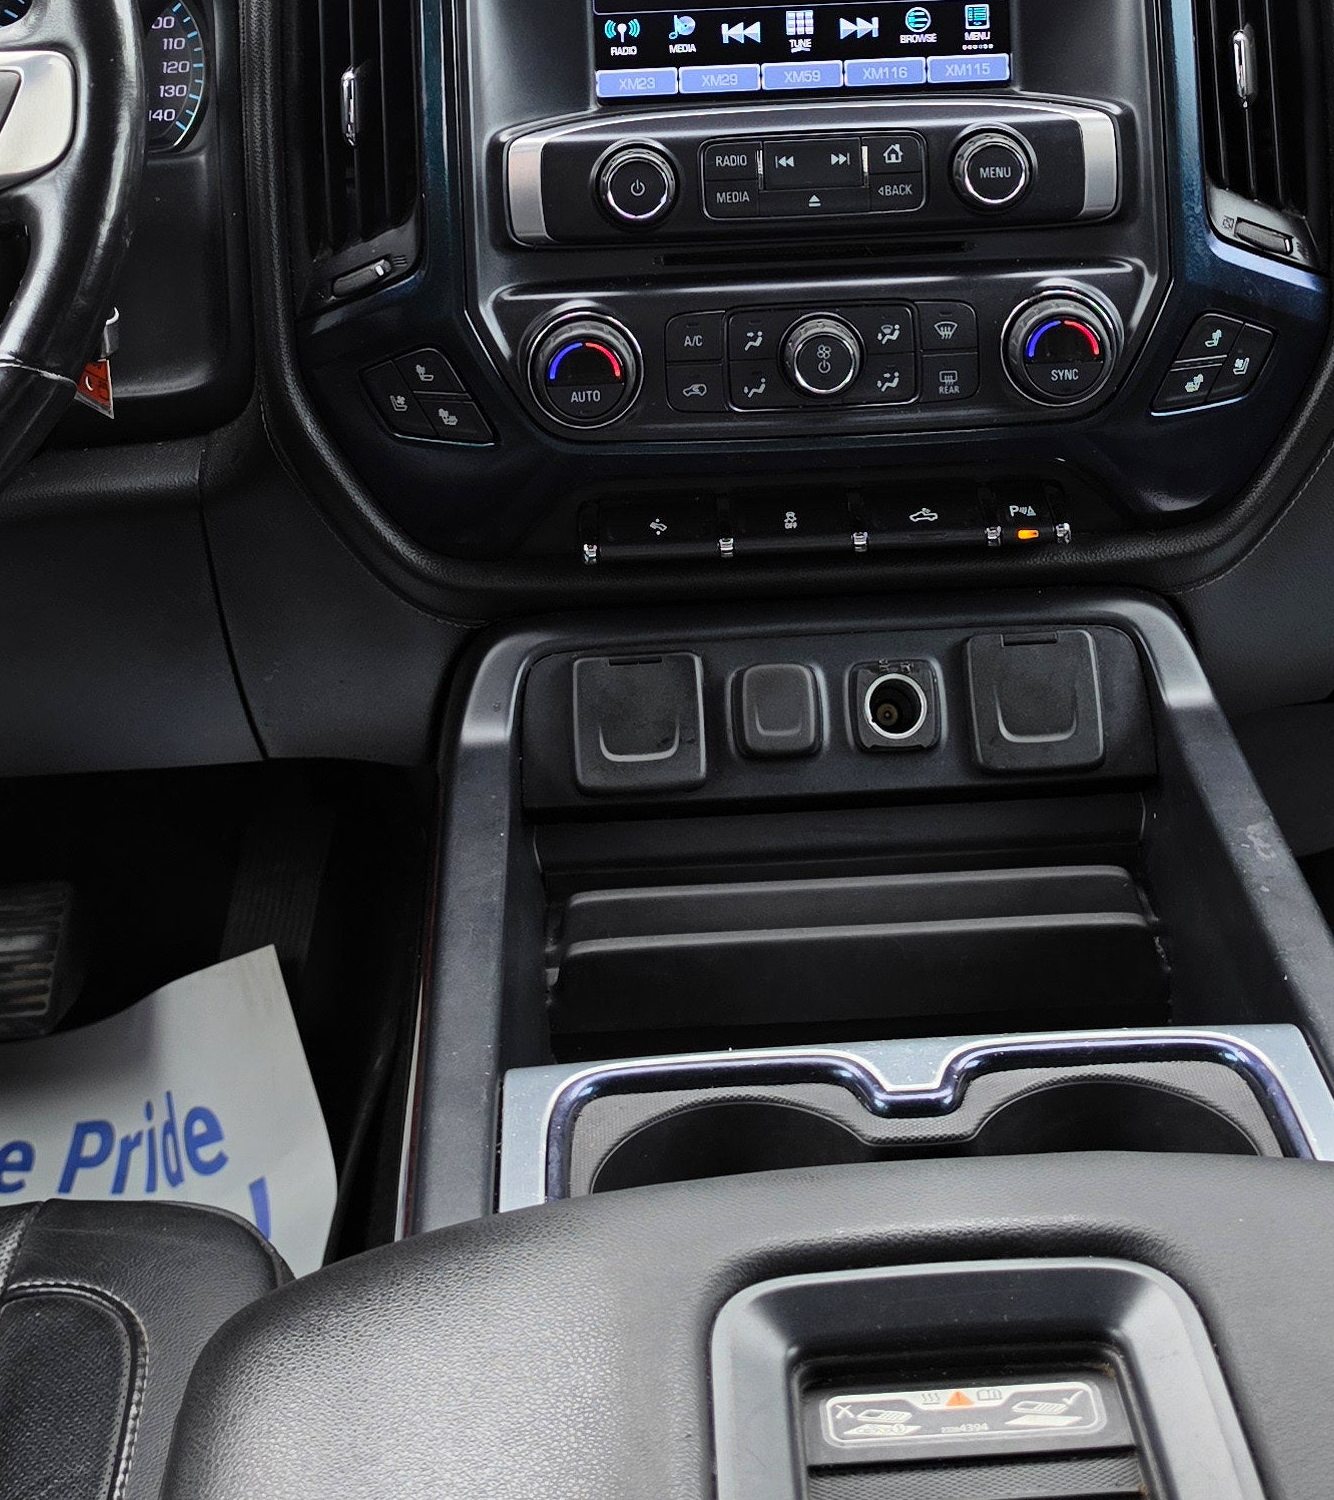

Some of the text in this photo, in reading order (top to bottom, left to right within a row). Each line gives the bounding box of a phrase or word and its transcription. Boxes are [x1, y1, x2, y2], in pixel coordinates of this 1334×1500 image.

[152, 16, 174, 29] 00
[900, 33, 937, 44] BROWSE
[964, 31, 991, 41] MENU
[163, 38, 185, 50] 110
[669, 43, 696, 54] MEDIA
[789, 38, 812, 49] TUNE
[610, 46, 637, 56] RADIO
[163, 61, 190, 73] 120
[701, 74, 738, 86] XM29
[783, 69, 821, 83] XM59
[862, 66, 907, 79] XM116
[945, 63, 991, 76] XM115
[159, 85, 187, 97] 130
[149, 109, 175, 121] 140
[715, 153, 748, 168] RADIO
[979, 165, 1012, 180] MENU
[884, 183, 913, 197] BACK
[716, 189, 750, 204] MEDIA
[683, 333, 703, 348] A/C
[1051, 367, 1080, 382] SYNC
[938, 384, 960, 395] REAR
[571, 390, 600, 404] AUTO
[57, 1091, 228, 1195] Pride
